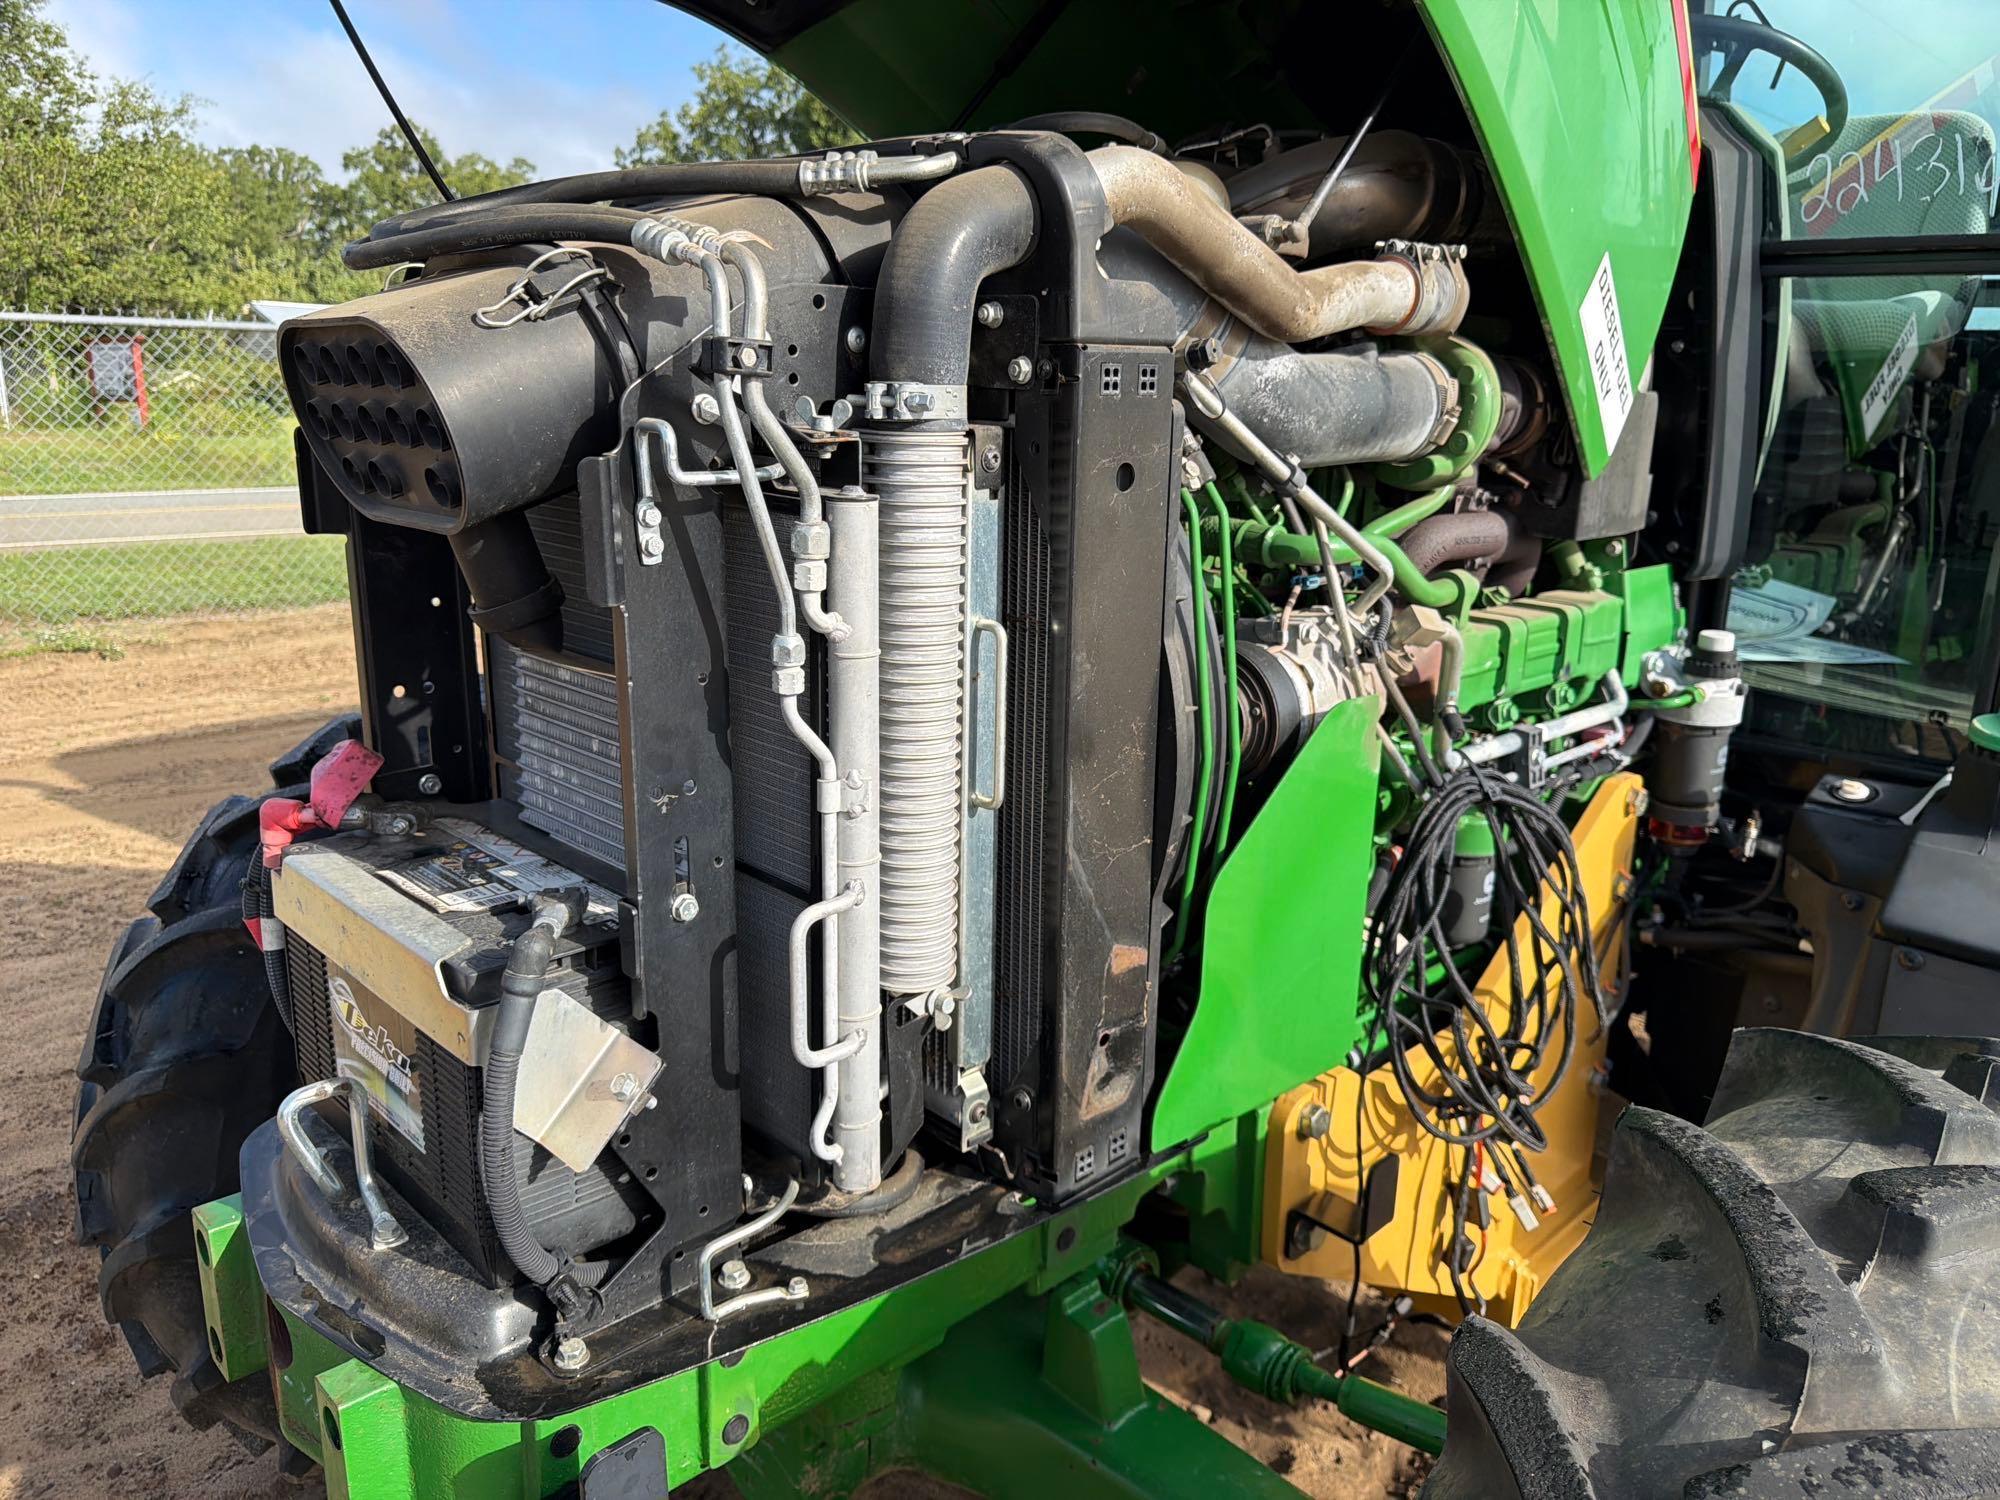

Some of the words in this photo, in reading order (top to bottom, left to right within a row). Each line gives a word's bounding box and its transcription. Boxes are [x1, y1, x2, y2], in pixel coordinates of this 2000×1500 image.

[1594, 339, 1612, 401] ONLY
[1598, 266, 1620, 361] DIESEL
[1614, 356, 1630, 415] FUEL
[340, 998, 411, 1077] Deka
[350, 1033, 389, 1078] PRECISION
